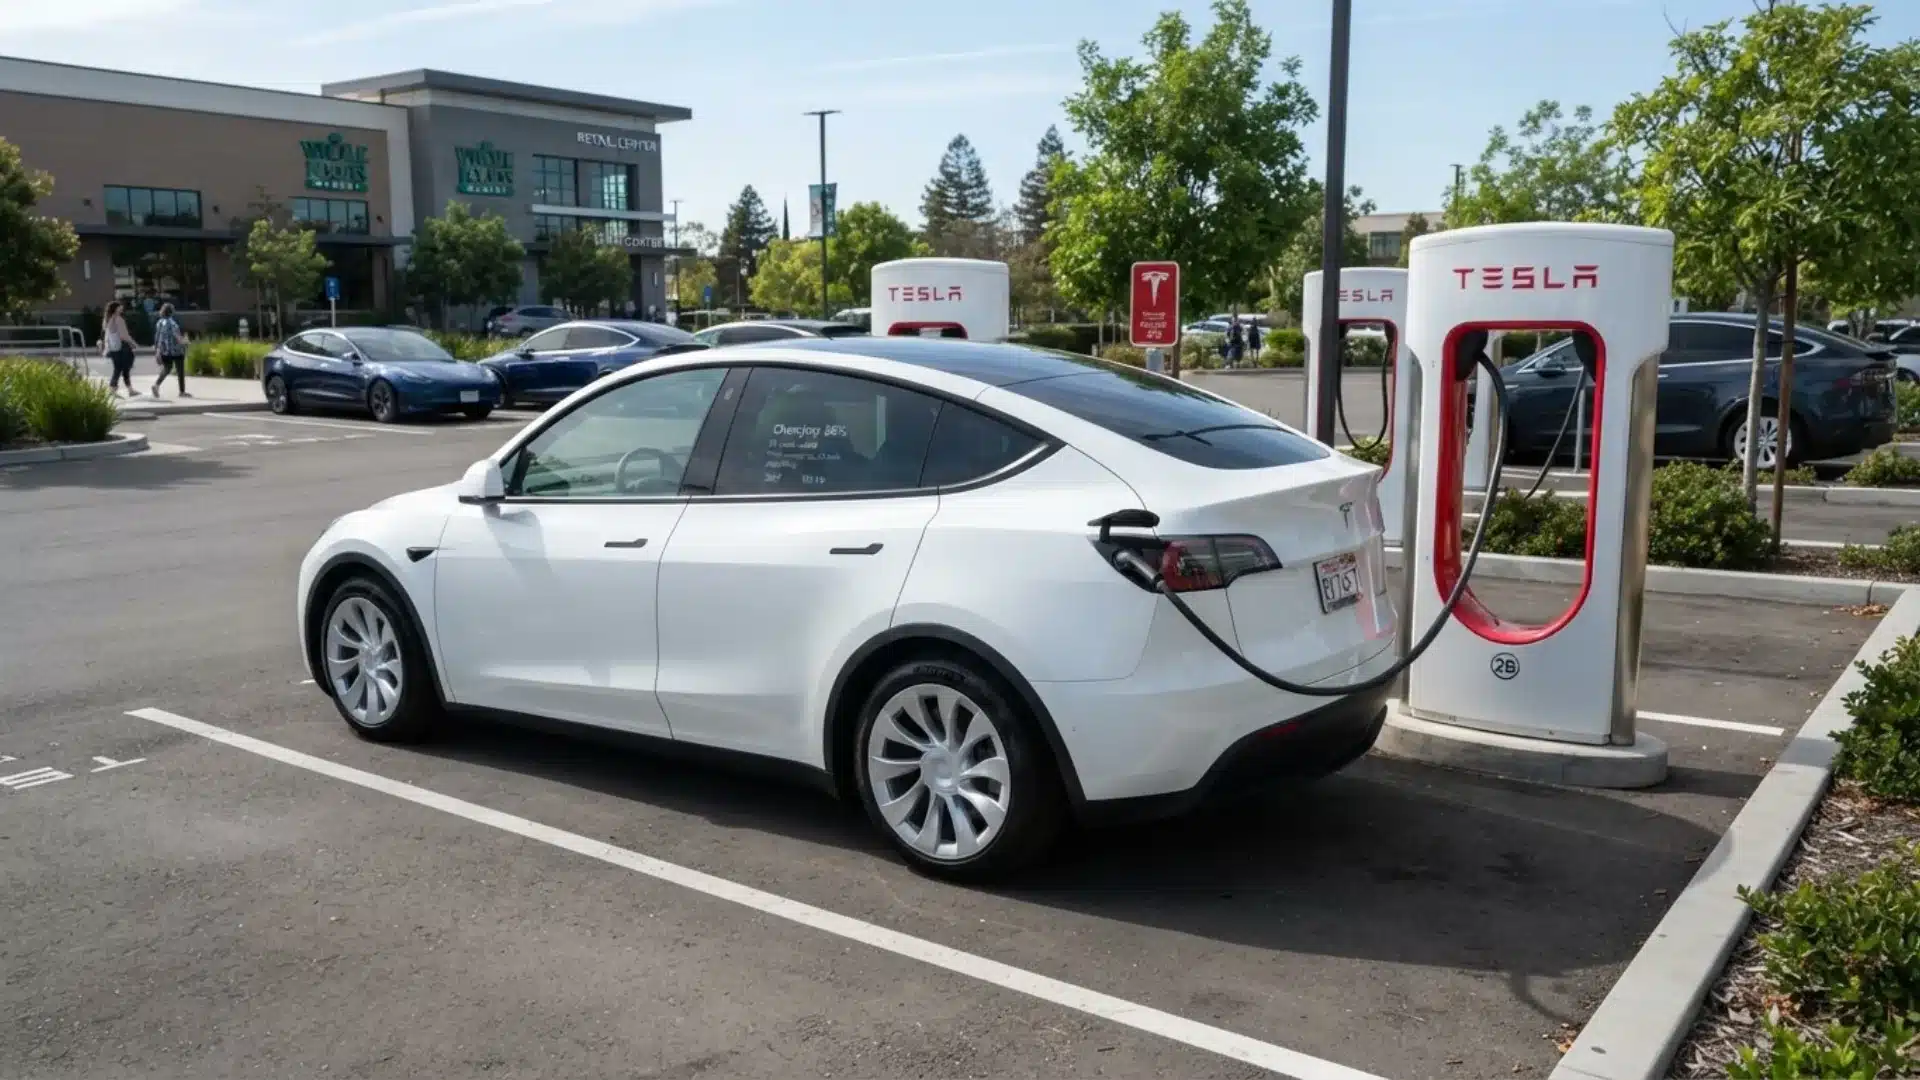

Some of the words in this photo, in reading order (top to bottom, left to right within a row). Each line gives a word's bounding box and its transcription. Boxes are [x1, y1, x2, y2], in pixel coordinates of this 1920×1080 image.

[1452, 265, 1599, 290] TESLA
[888, 286, 962, 302] TESLA
[1338, 288, 1394, 302] ESLA
